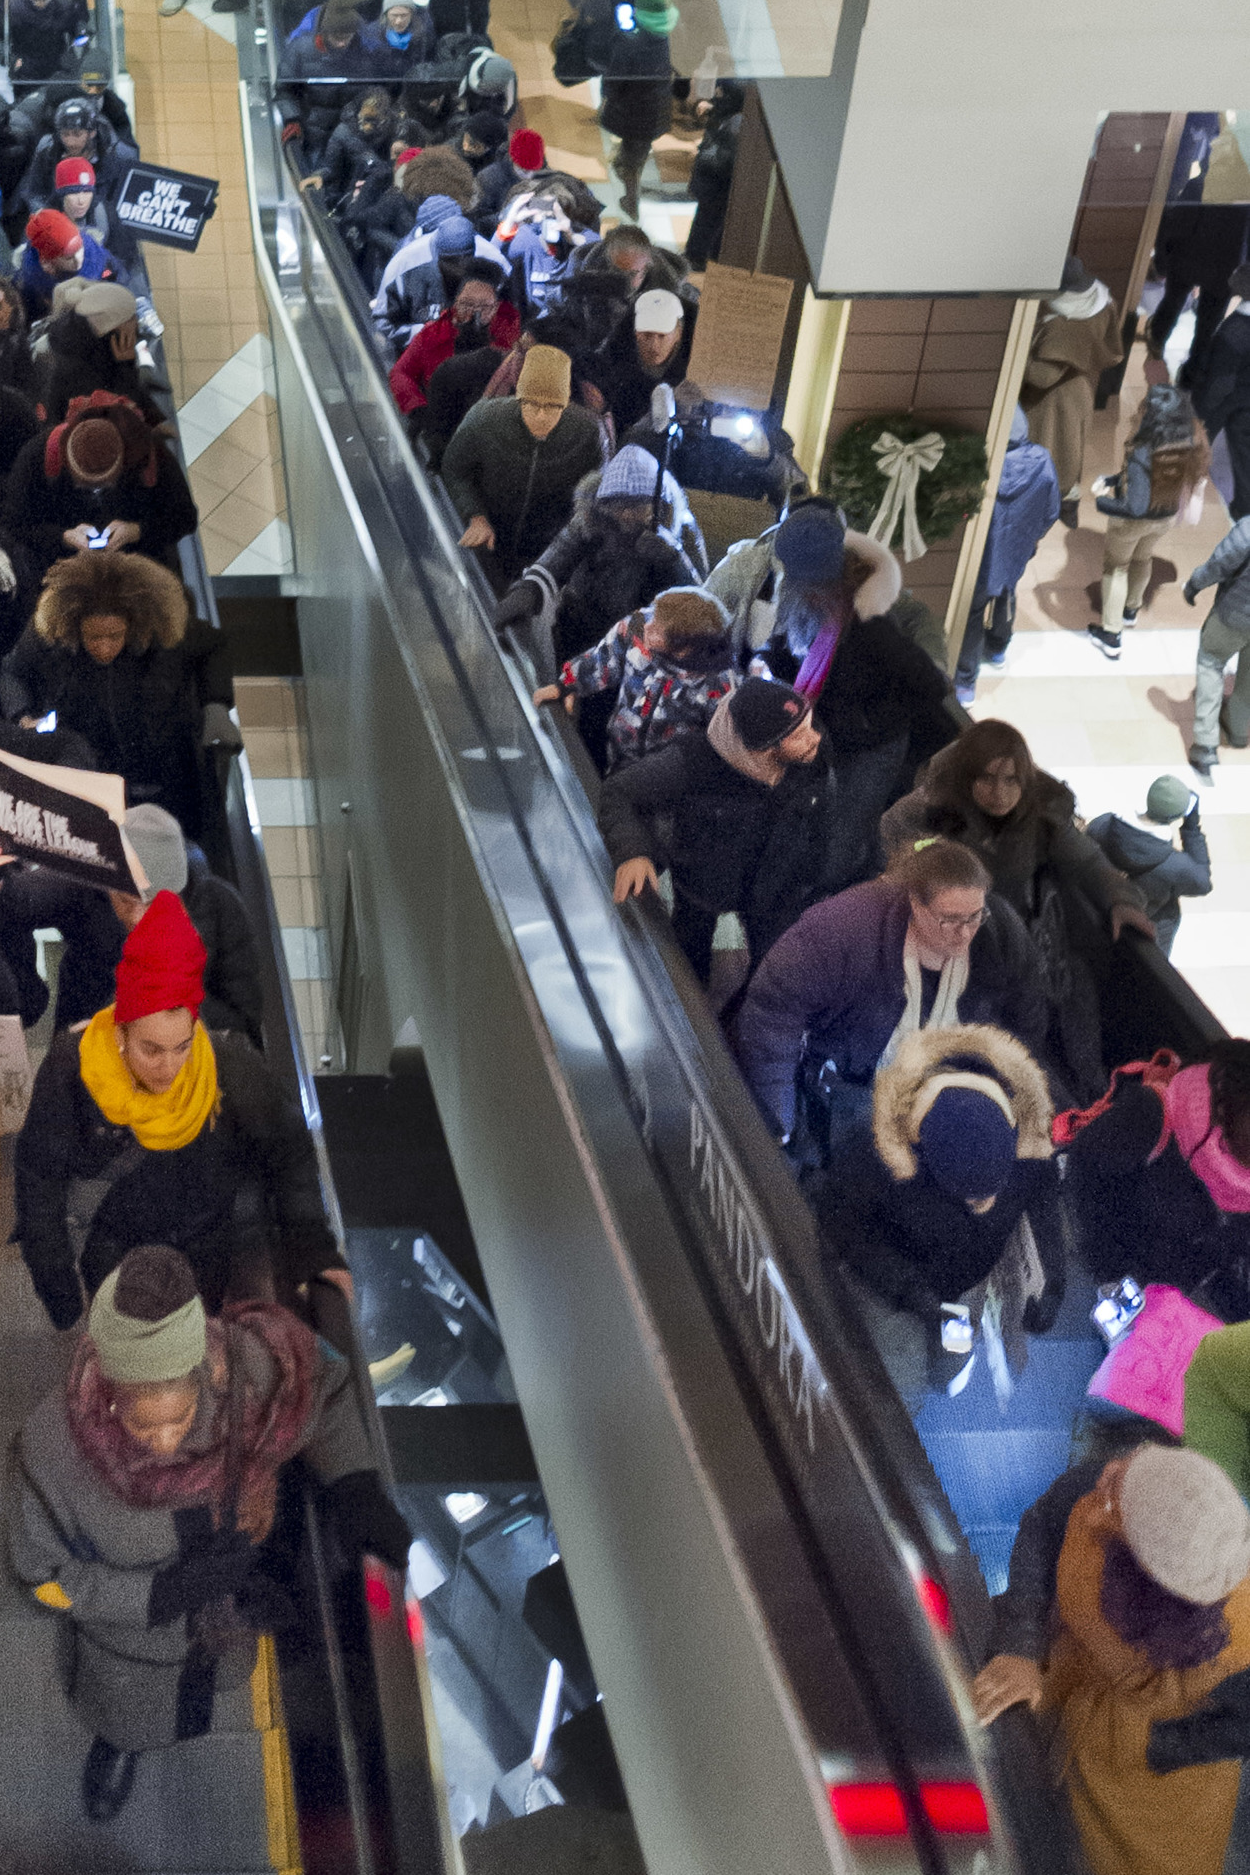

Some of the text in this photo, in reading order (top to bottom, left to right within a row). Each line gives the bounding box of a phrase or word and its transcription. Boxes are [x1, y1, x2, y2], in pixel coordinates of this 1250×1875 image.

[153, 179, 182, 198] WE
[138, 191, 190, 216] CAN'T
[119, 201, 198, 234] BREATHE
